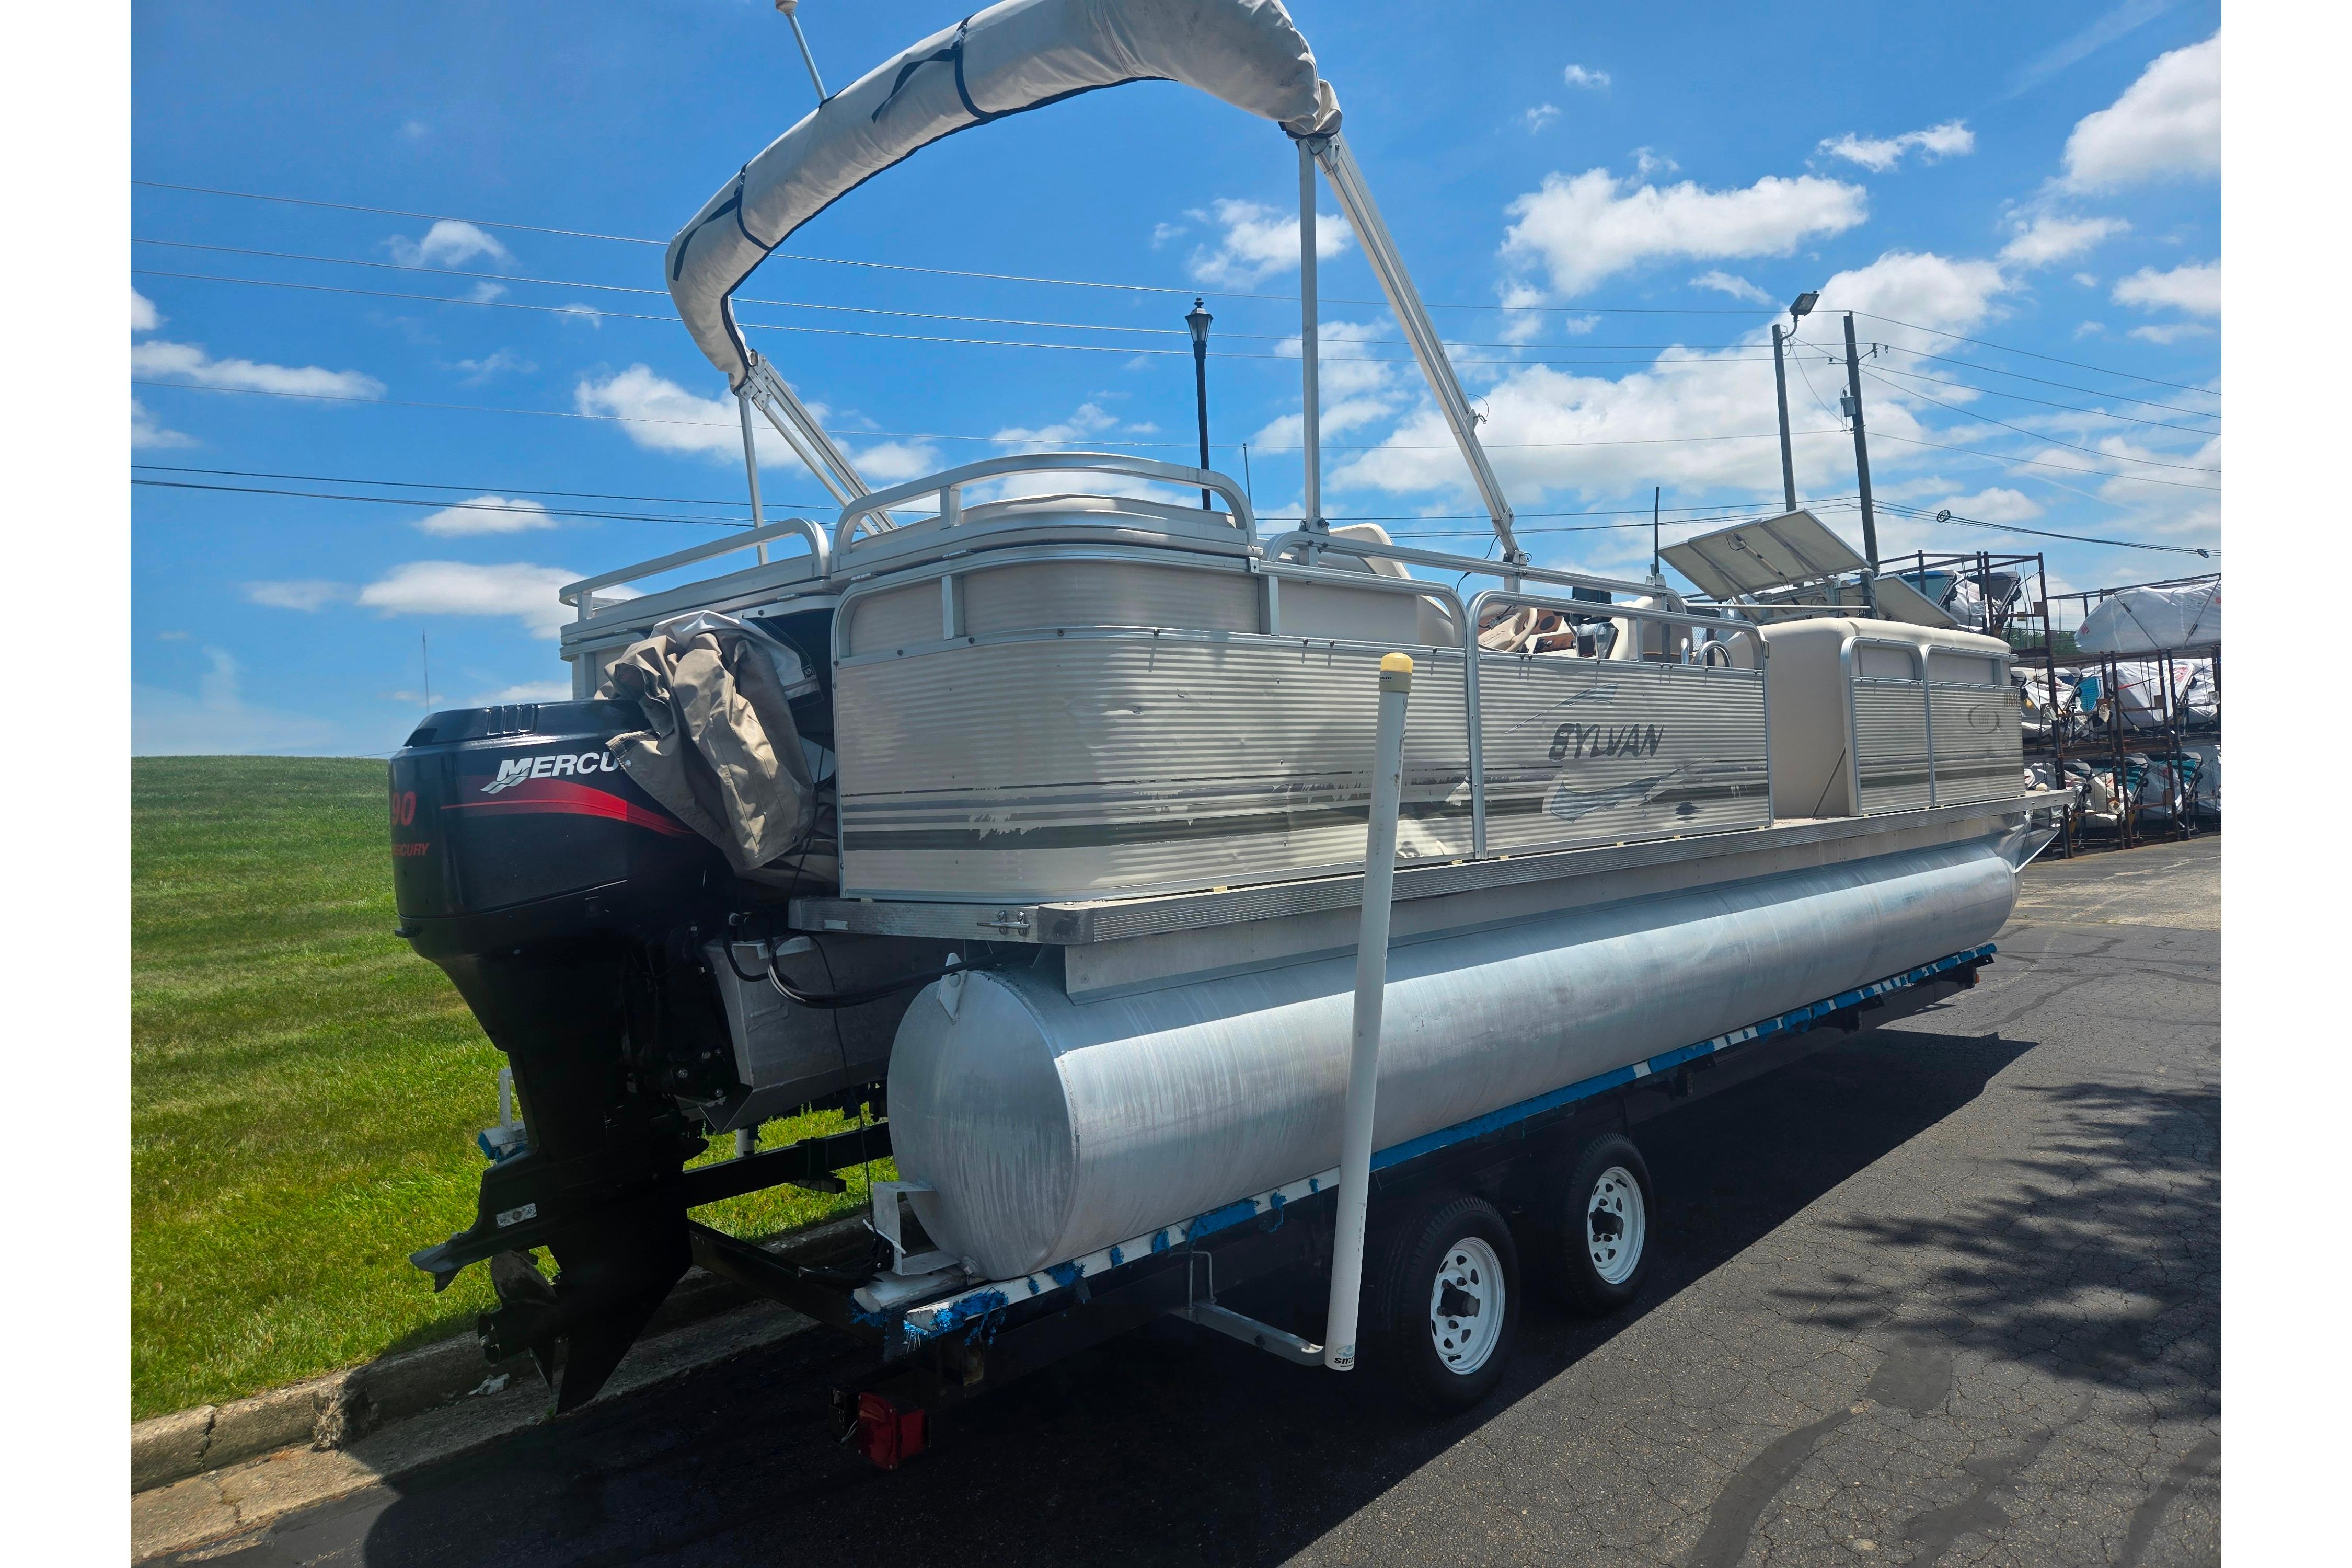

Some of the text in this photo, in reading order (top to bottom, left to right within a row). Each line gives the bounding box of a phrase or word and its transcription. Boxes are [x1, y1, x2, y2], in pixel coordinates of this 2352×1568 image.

[1548, 722, 1665, 762] SYLVAN
[496, 751, 619, 782] MERCU
[393, 791, 417, 826] 90
[393, 843, 430, 856] ERCURY
